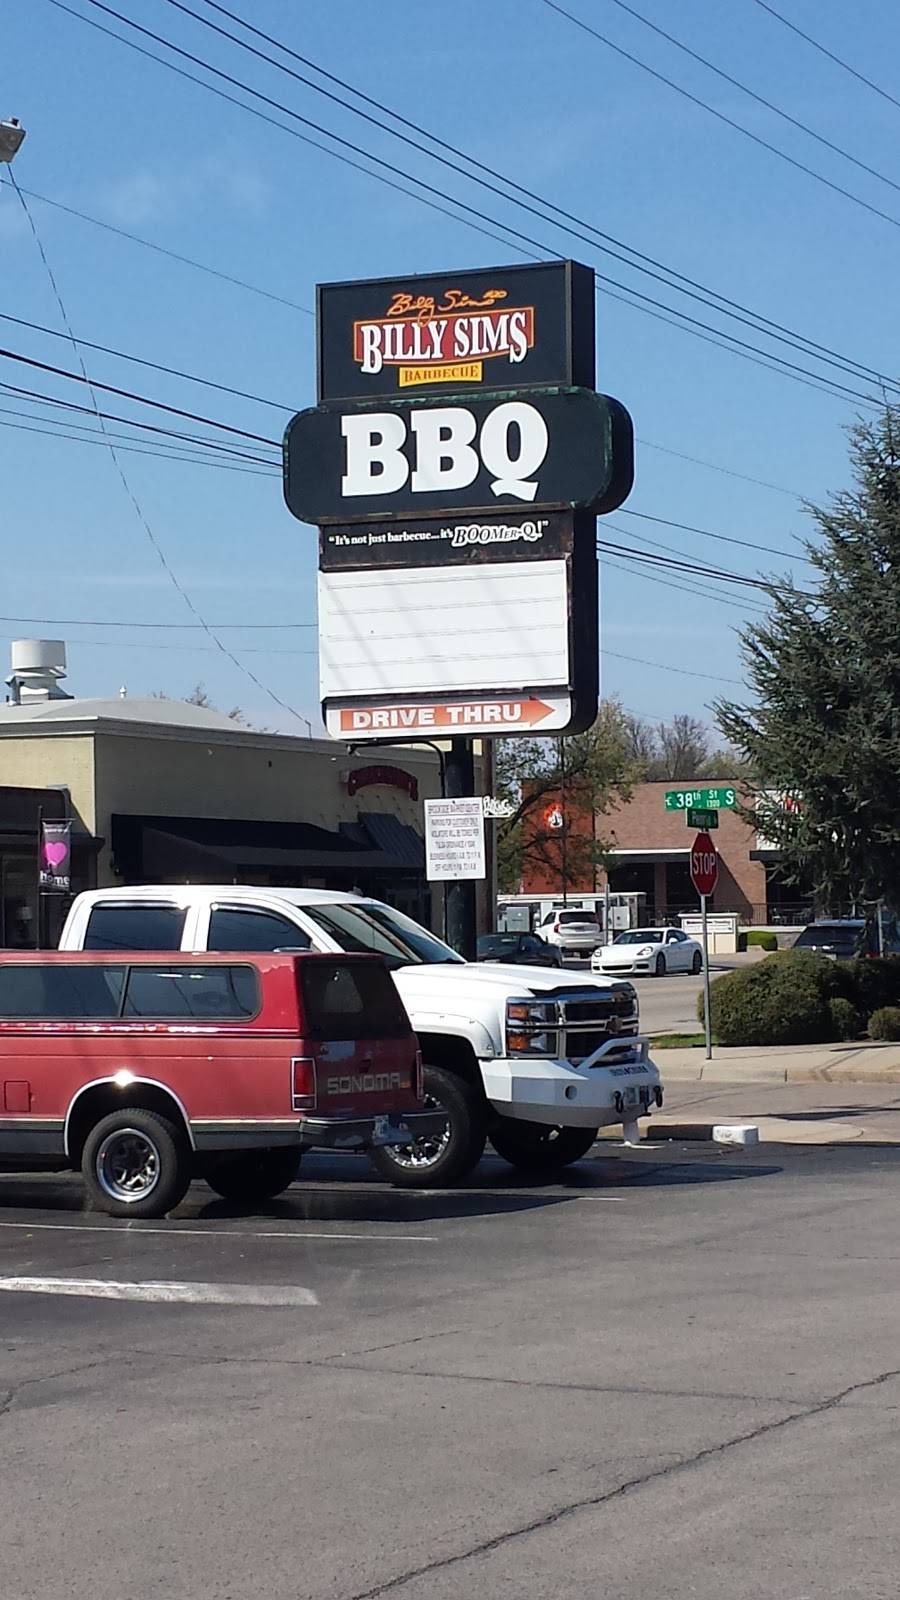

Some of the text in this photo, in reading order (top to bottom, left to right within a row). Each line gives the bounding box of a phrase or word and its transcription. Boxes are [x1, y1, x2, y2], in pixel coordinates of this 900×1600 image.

[360, 311, 528, 374] BILLY SIMS
[403, 364, 480, 383] BARBECUE
[340, 401, 549, 502] BBQ
[351, 535, 367, 545] not
[367, 534, 386, 546] just
[352, 702, 522, 729] DRIVE THRU
[676, 791, 702, 808] 38th
[708, 790, 718, 799] St
[725, 789, 735, 805] S
[692, 853, 716, 875] STOP
[39, 870, 71, 885] home
[327, 1072, 401, 1095] SONOMA
